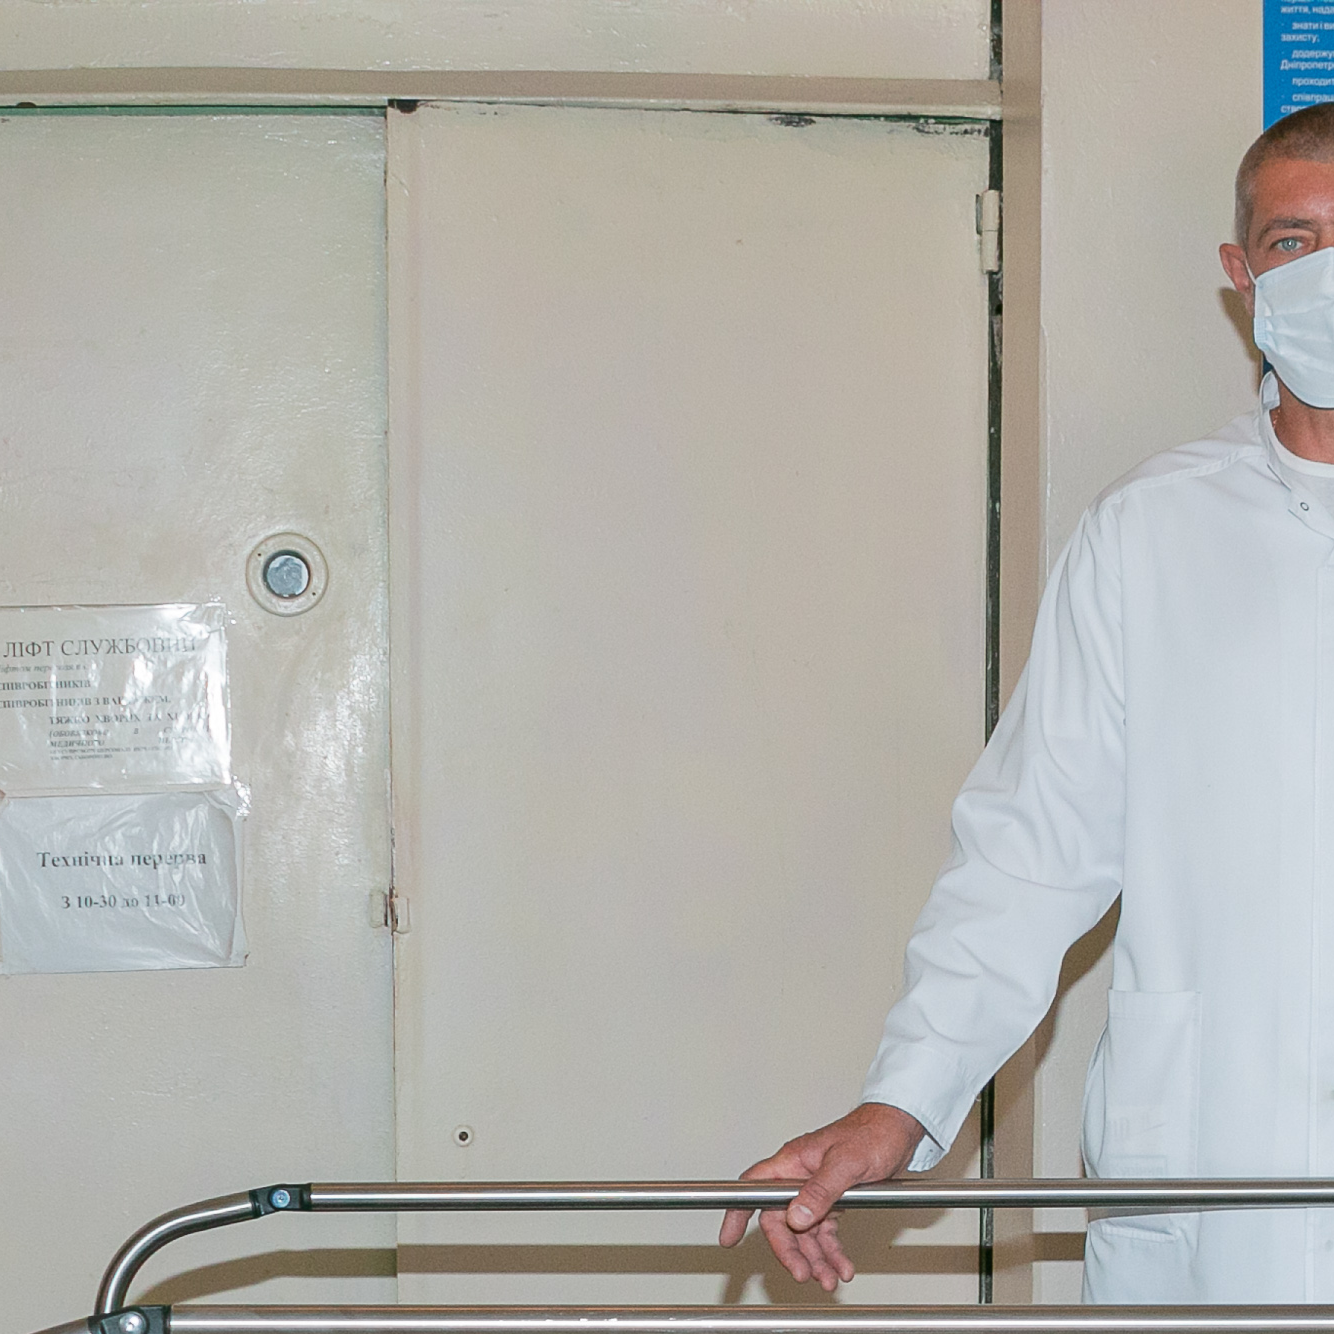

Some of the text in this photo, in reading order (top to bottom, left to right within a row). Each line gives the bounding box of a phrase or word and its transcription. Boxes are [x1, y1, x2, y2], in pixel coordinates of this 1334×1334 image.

[3, 640, 54, 658] ЛІФТ
[36, 851, 207, 869] Технічна перерва
[77, 895, 116, 909] 10-30
[122, 897, 138, 908] до
[145, 894, 185, 908] 11-00
